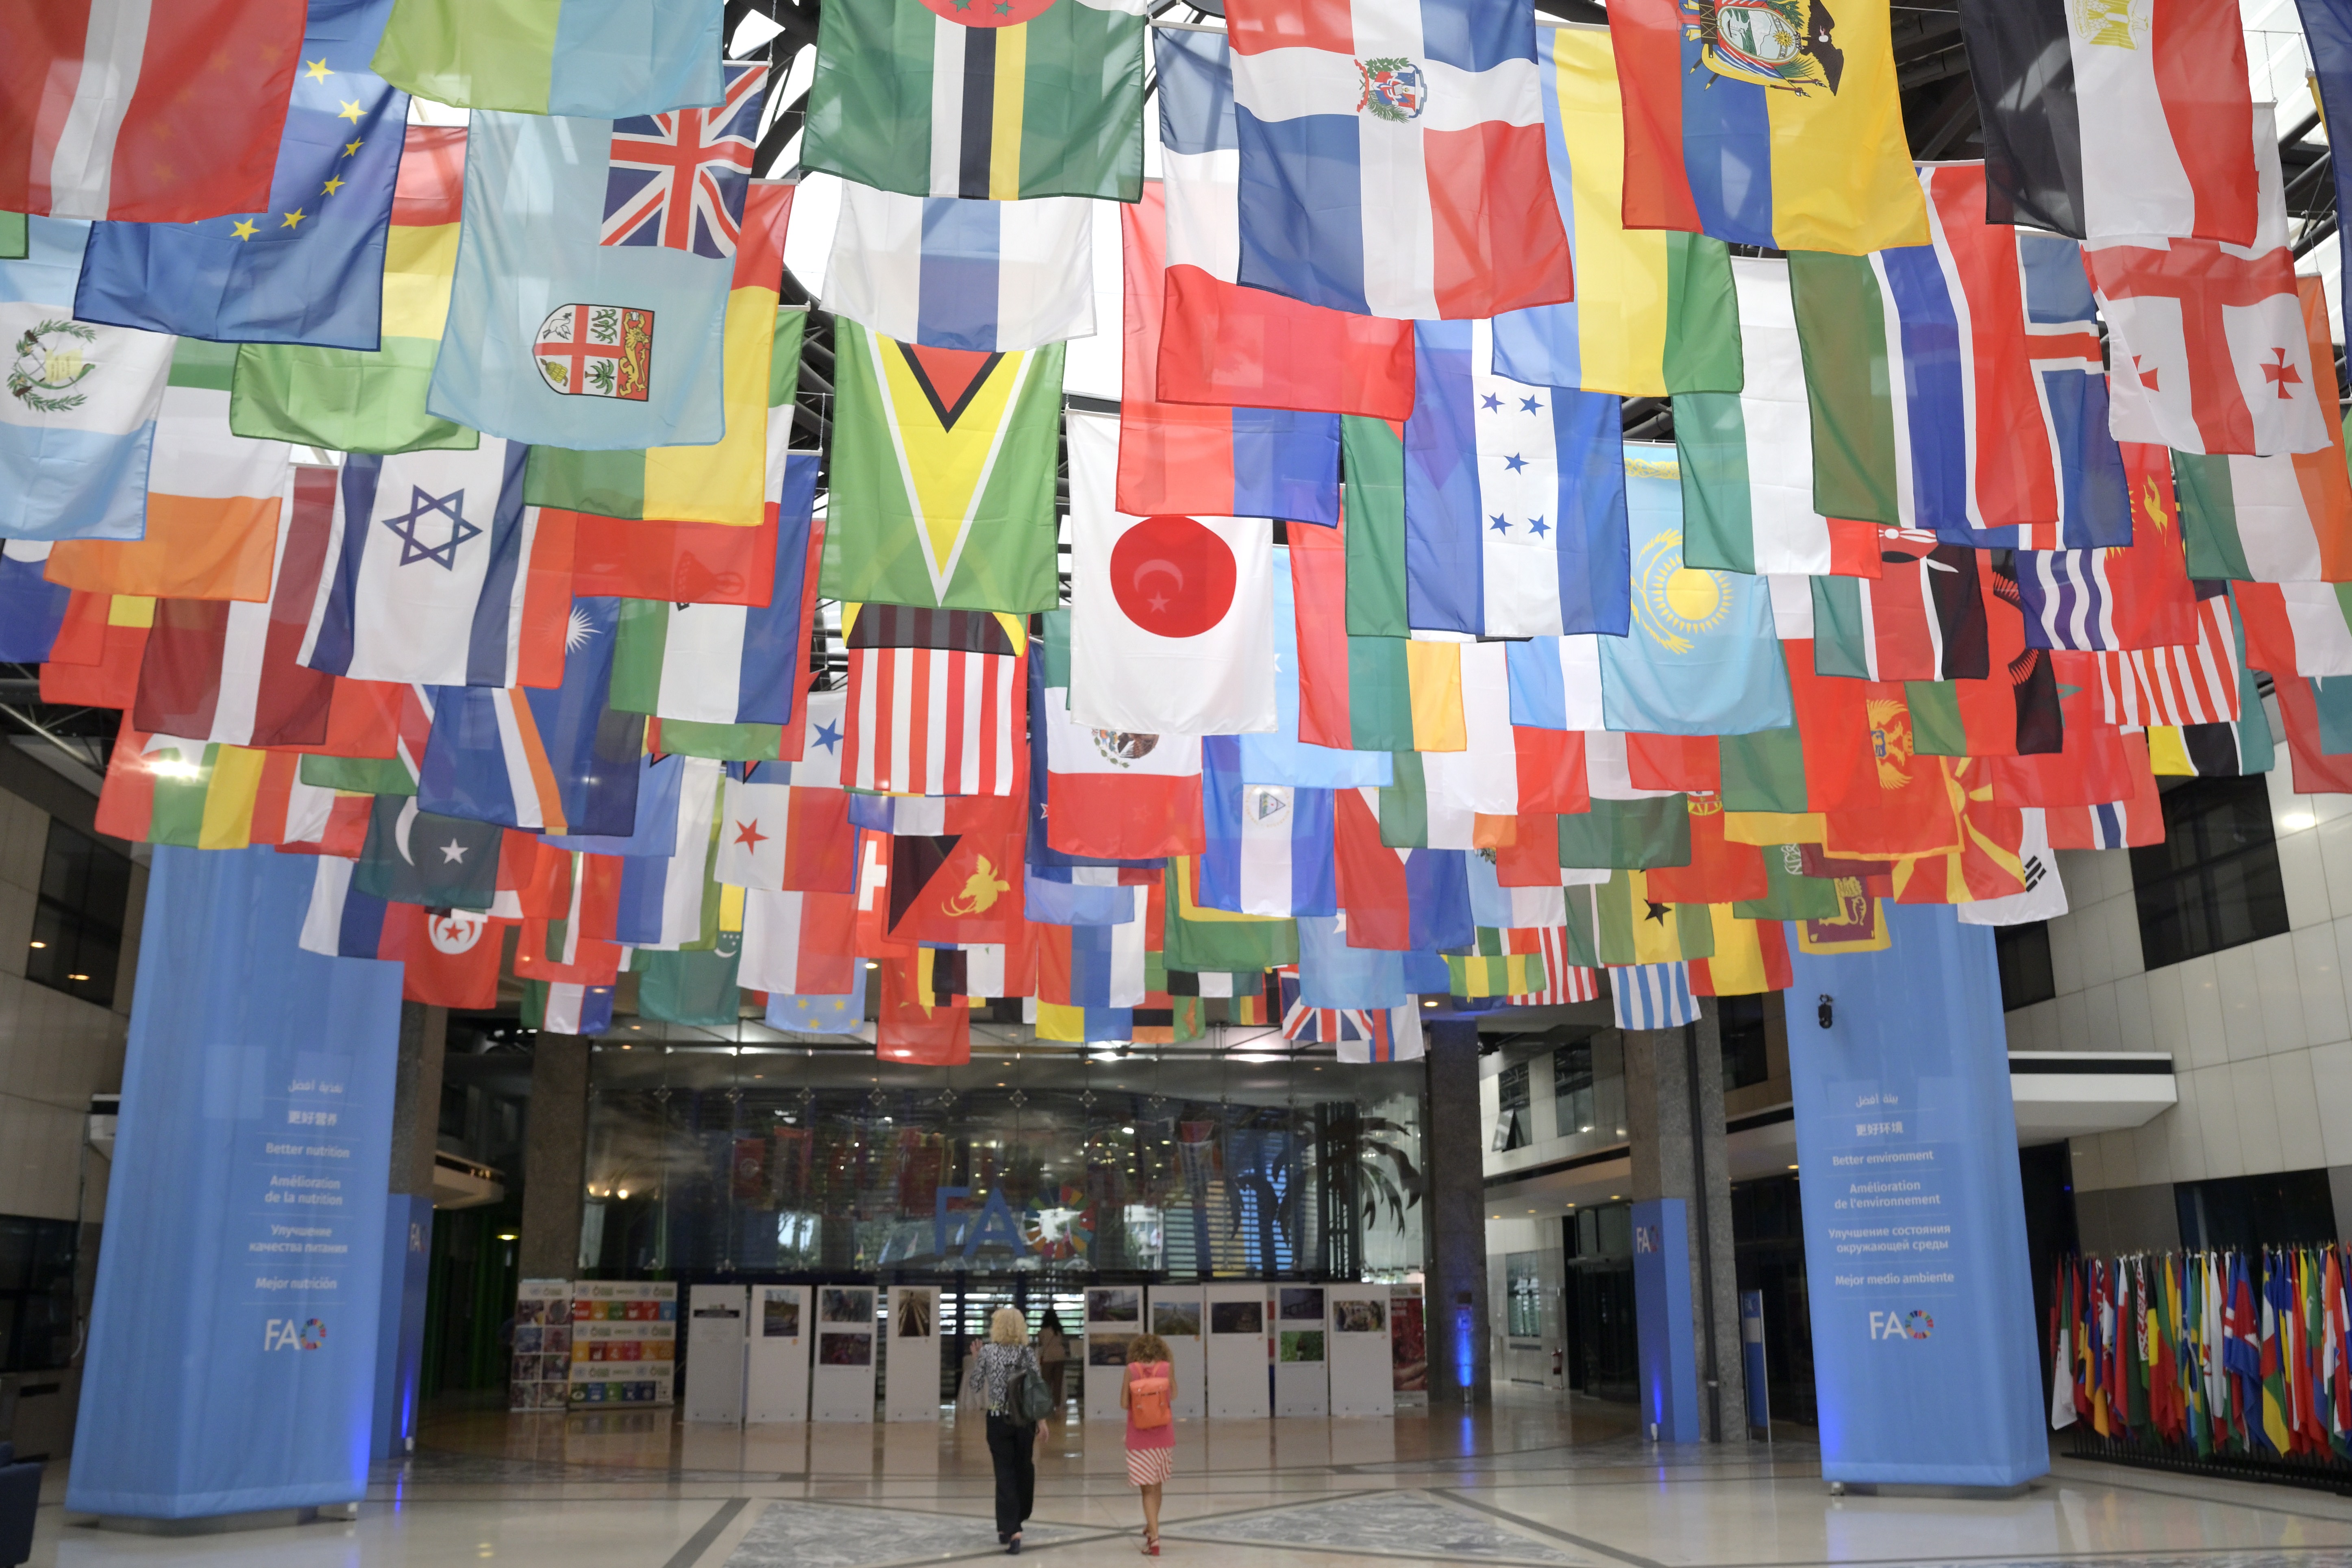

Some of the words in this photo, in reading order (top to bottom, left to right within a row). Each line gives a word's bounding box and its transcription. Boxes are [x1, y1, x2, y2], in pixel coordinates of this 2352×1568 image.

[1856, 1121, 1903, 1136] 更好环境
[266, 1142, 304, 1155] Better
[306, 1146, 350, 1158] nutrition
[1832, 1156, 1864, 1166] Better
[1867, 1150, 1934, 1163] environment
[270, 1175, 341, 1189] Amélioration
[1850, 1180, 1921, 1193] Amélioration
[265, 1190, 280, 1203] de
[284, 1191, 295, 1203] la
[298, 1193, 343, 1205] nutrition
[1834, 1199, 1847, 1209] de
[1850, 1194, 1941, 1208] l'environnement
[1828, 1228, 1889, 1240] Улучшение
[1892, 1225, 1950, 1236] состояния
[1837, 1240, 1909, 1255] окружающей
[1912, 1240, 1948, 1251] среды
[255, 1276, 289, 1291] Mejor
[290, 1277, 337, 1289] nutrición
[1835, 1274, 1864, 1287] Mejor
[1867, 1273, 1900, 1284] medio
[1903, 1272, 1954, 1283] ambiente
[1869, 1310, 1934, 1340] FAO
